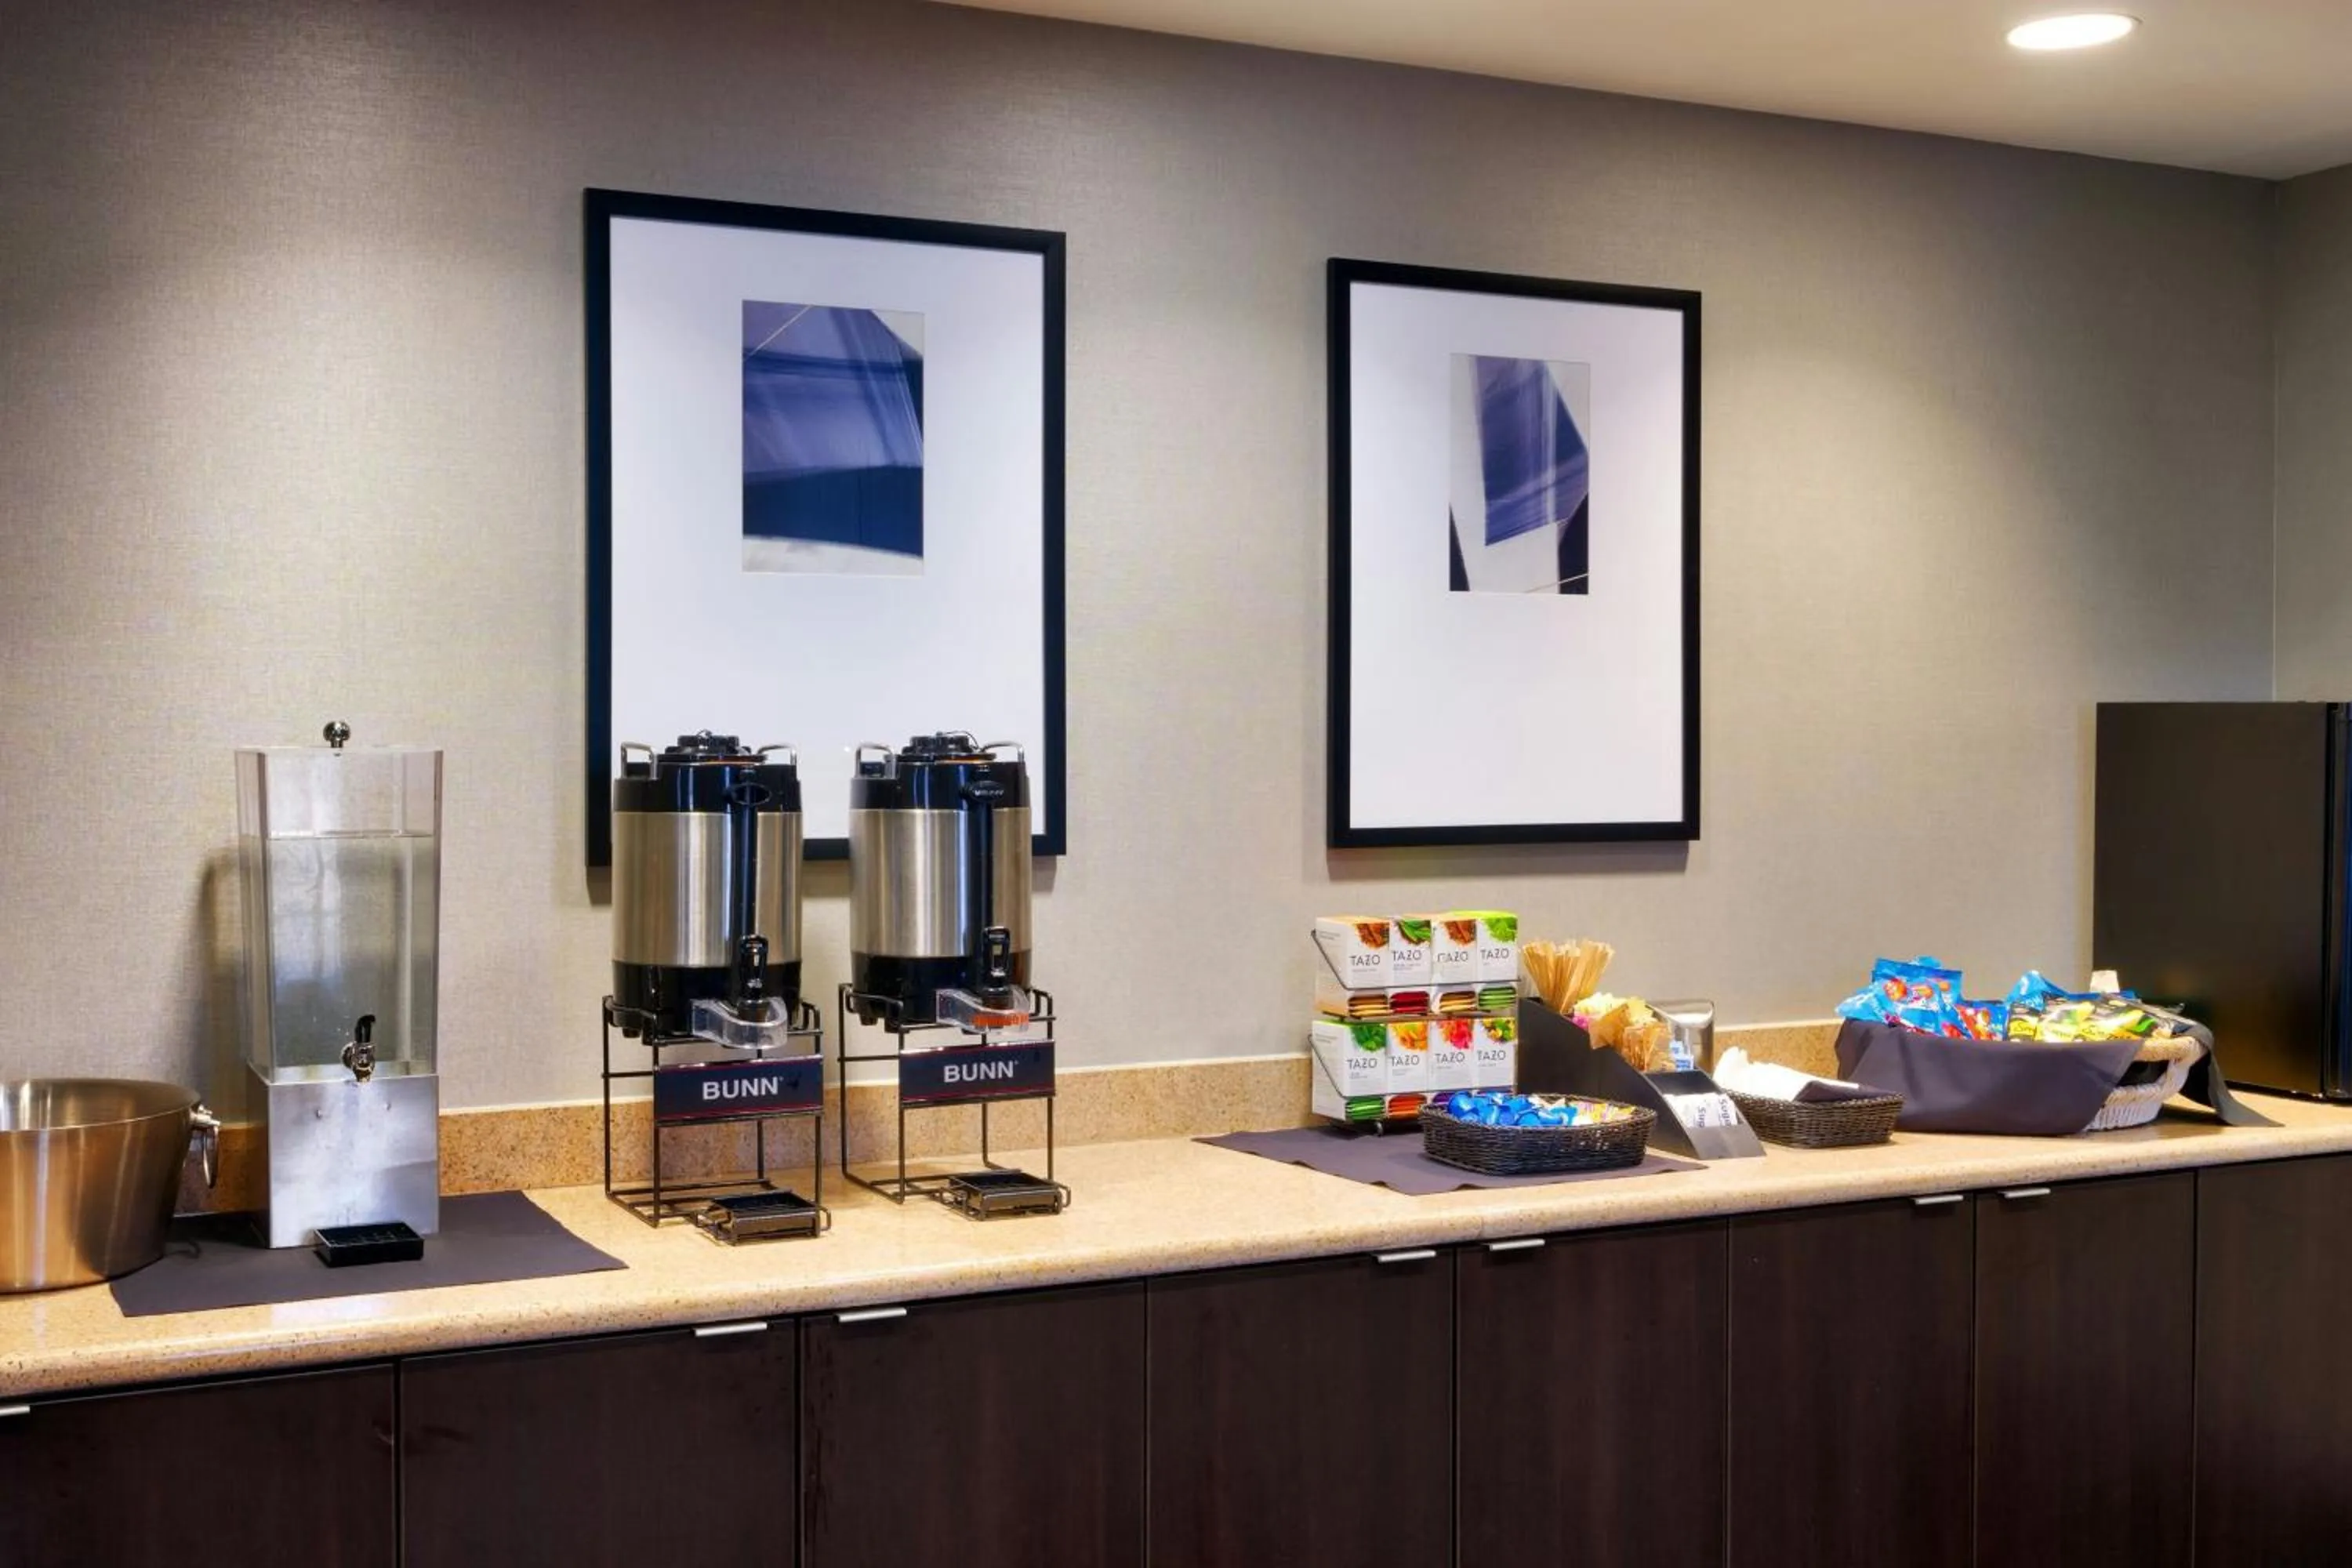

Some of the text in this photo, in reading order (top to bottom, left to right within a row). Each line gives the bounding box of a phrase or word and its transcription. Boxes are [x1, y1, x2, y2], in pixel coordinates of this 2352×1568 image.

[1348, 954, 1381, 966] TAZO
[1392, 949, 1421, 961] TAZO
[1480, 948, 1509, 960] TAZO
[1390, 1054, 1420, 1066] TAZO
[1435, 1051, 1465, 1063] TAZO
[1477, 1050, 1506, 1061] TAZO
[1347, 1057, 1377, 1069] TAZO
[943, 1060, 1014, 1083] BUNN
[702, 1076, 779, 1100] BUNN
